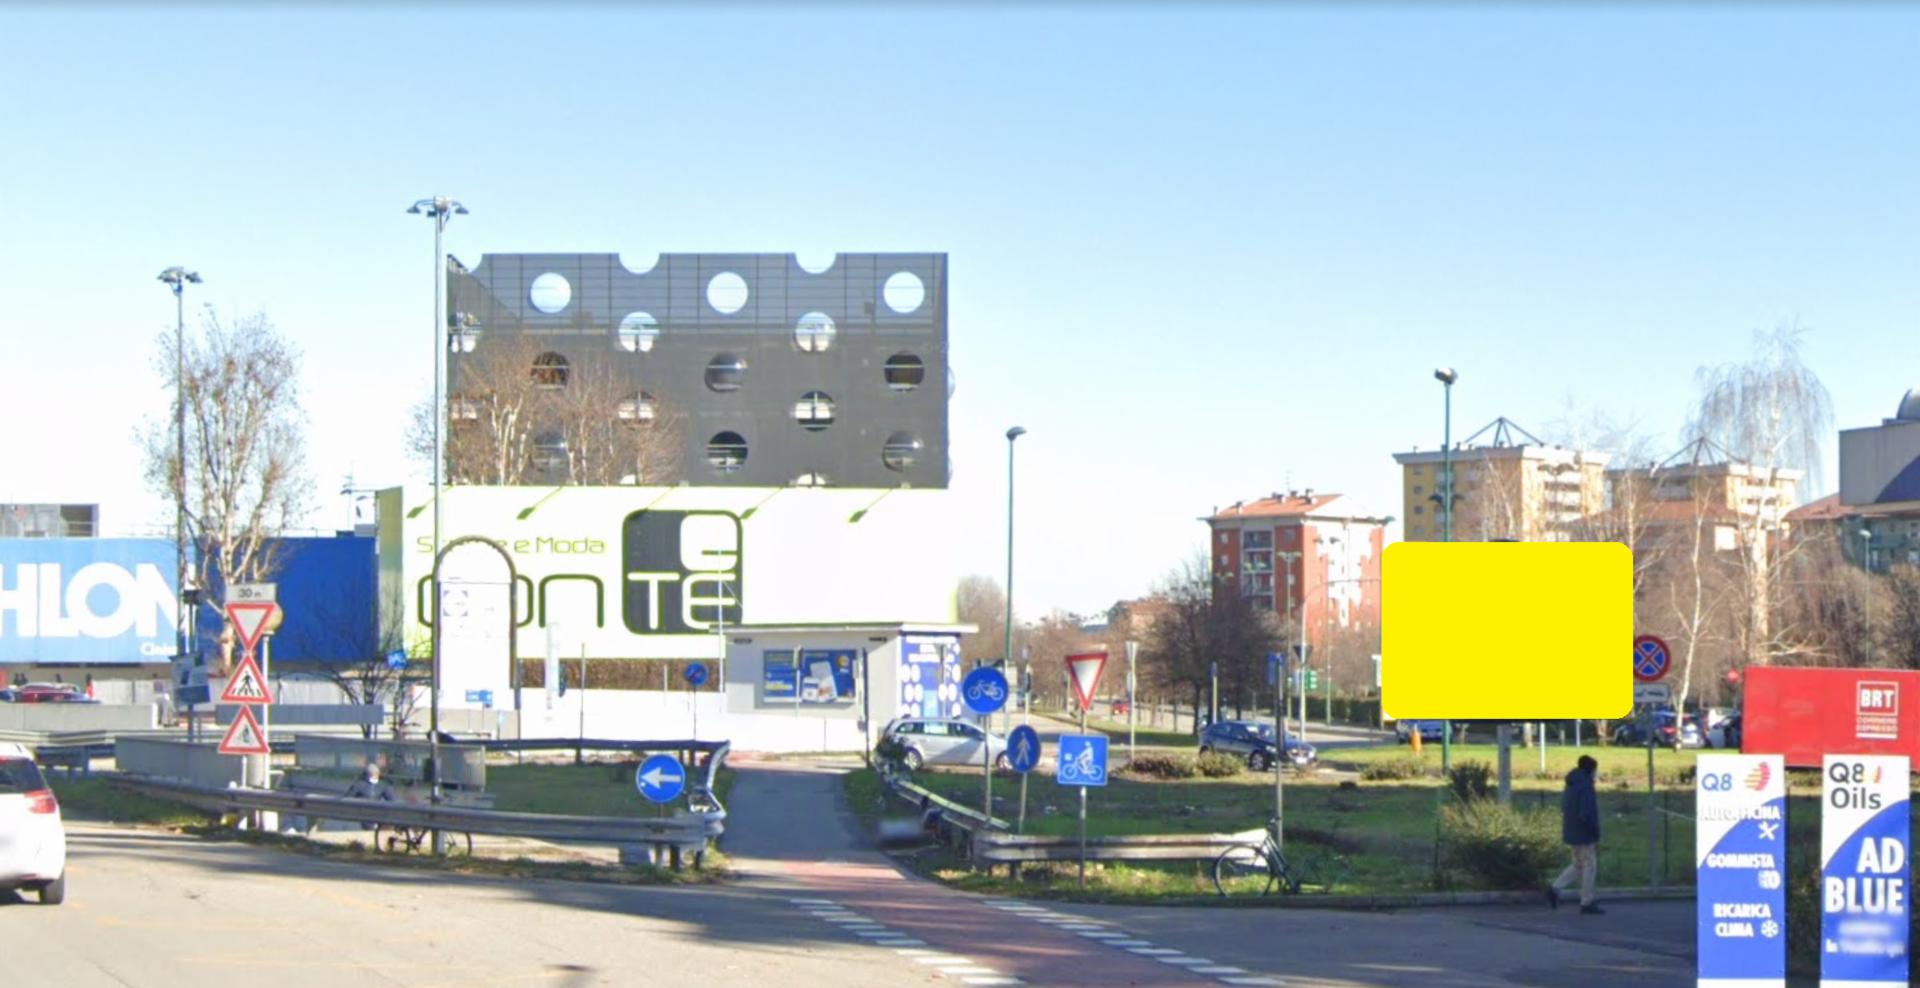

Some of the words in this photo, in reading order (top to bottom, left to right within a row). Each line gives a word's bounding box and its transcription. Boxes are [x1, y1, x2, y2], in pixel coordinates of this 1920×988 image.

[536, 536, 605, 554] Moda
[1861, 689, 1895, 708] BRT
[1701, 772, 1733, 792] Q8
[1828, 762, 1865, 784] Q8
[1830, 786, 1882, 810] Oils
[1856, 836, 1905, 874] AD
[1825, 876, 1904, 915] BLUE
[1713, 903, 1772, 918] RICARICA
[1715, 922, 1755, 937] CLIMA
